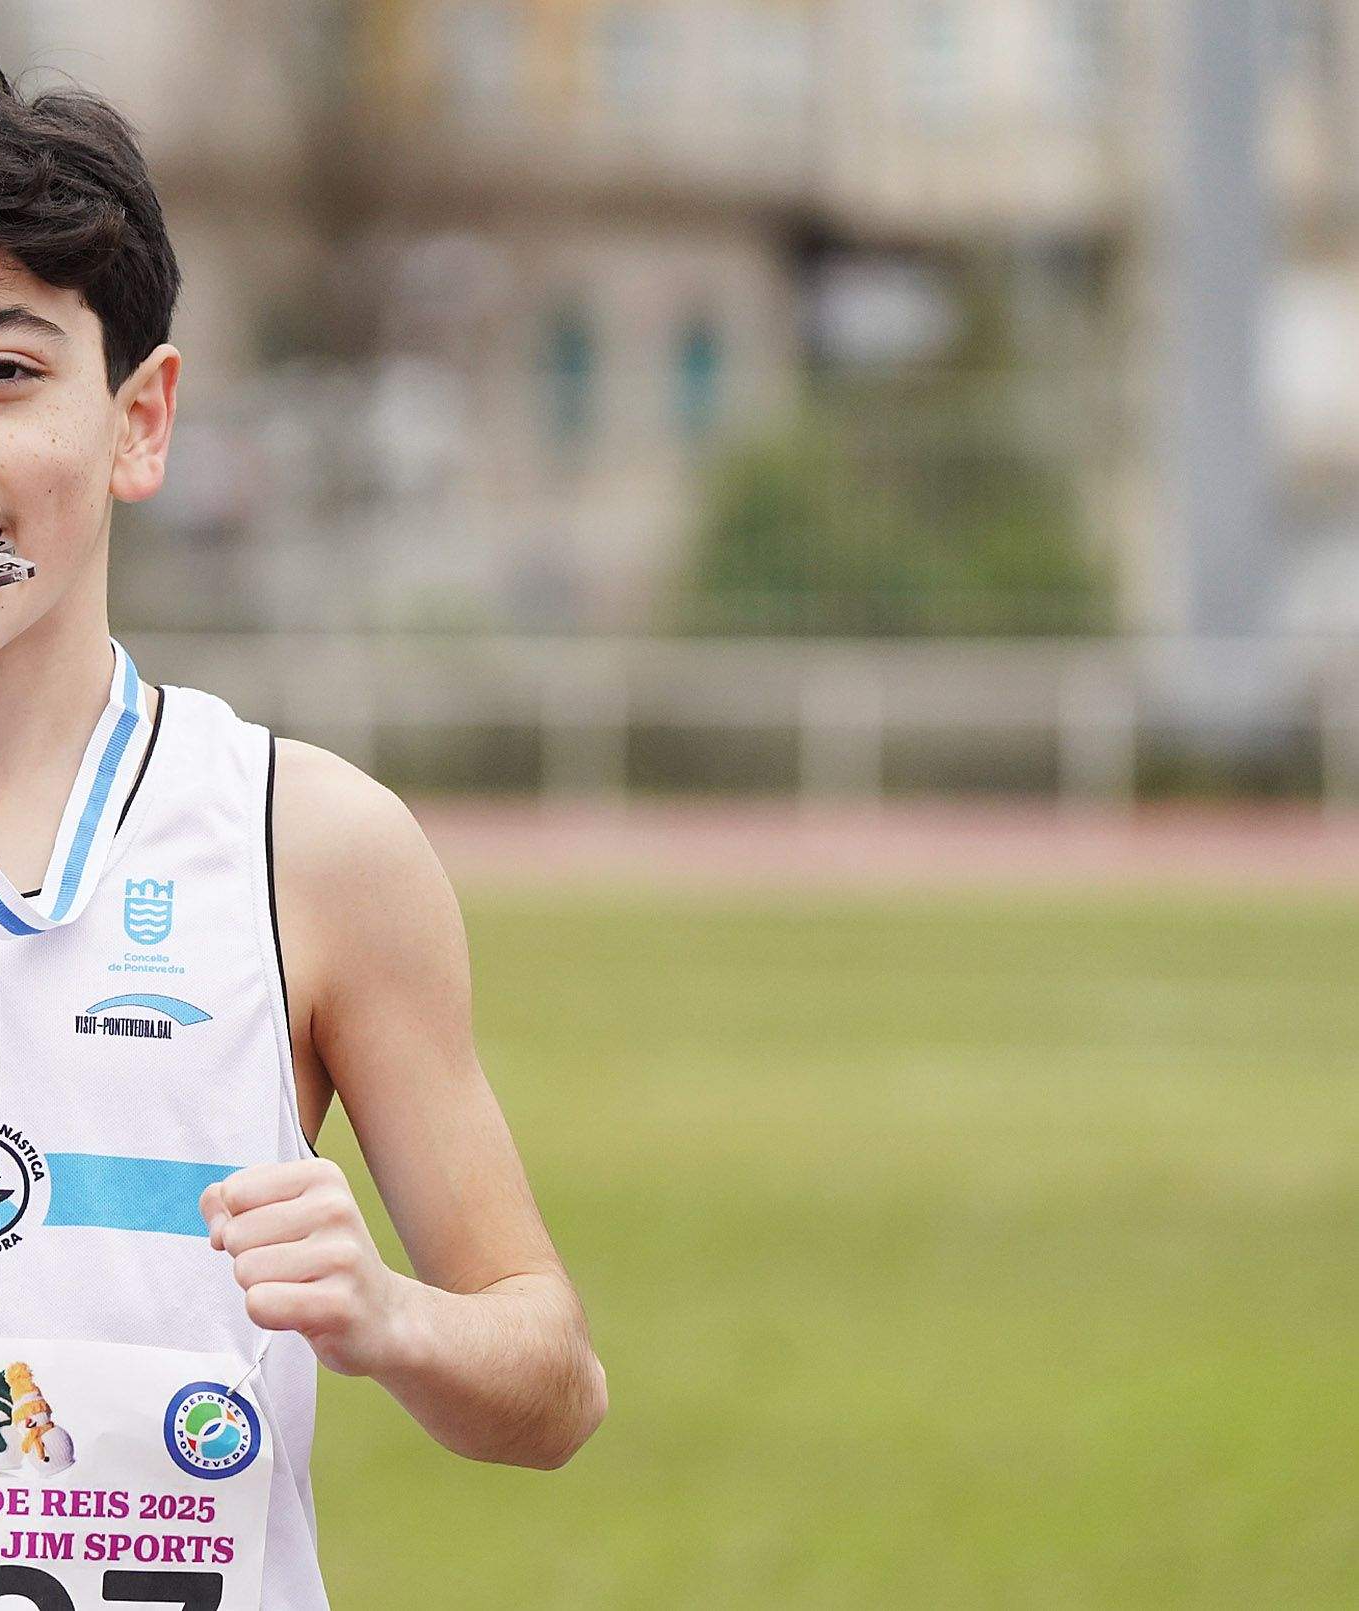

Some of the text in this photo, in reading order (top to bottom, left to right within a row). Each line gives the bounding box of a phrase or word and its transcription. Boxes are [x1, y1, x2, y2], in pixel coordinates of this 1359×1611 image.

[124, 953, 170, 963] Concello
[124, 964, 185, 974] Pontevedra
[75, 1015, 172, 1039] VISIT-PONTEVEDRA.GAL
[182, 1394, 242, 1417] DEPORTE
[177, 1430, 249, 1468] PONTEVEDRA
[41, 1489, 130, 1518] REIS
[139, 1494, 215, 1523] 2025
[0, 1531, 74, 1560] JIM
[84, 1534, 234, 1564] SPORTS
